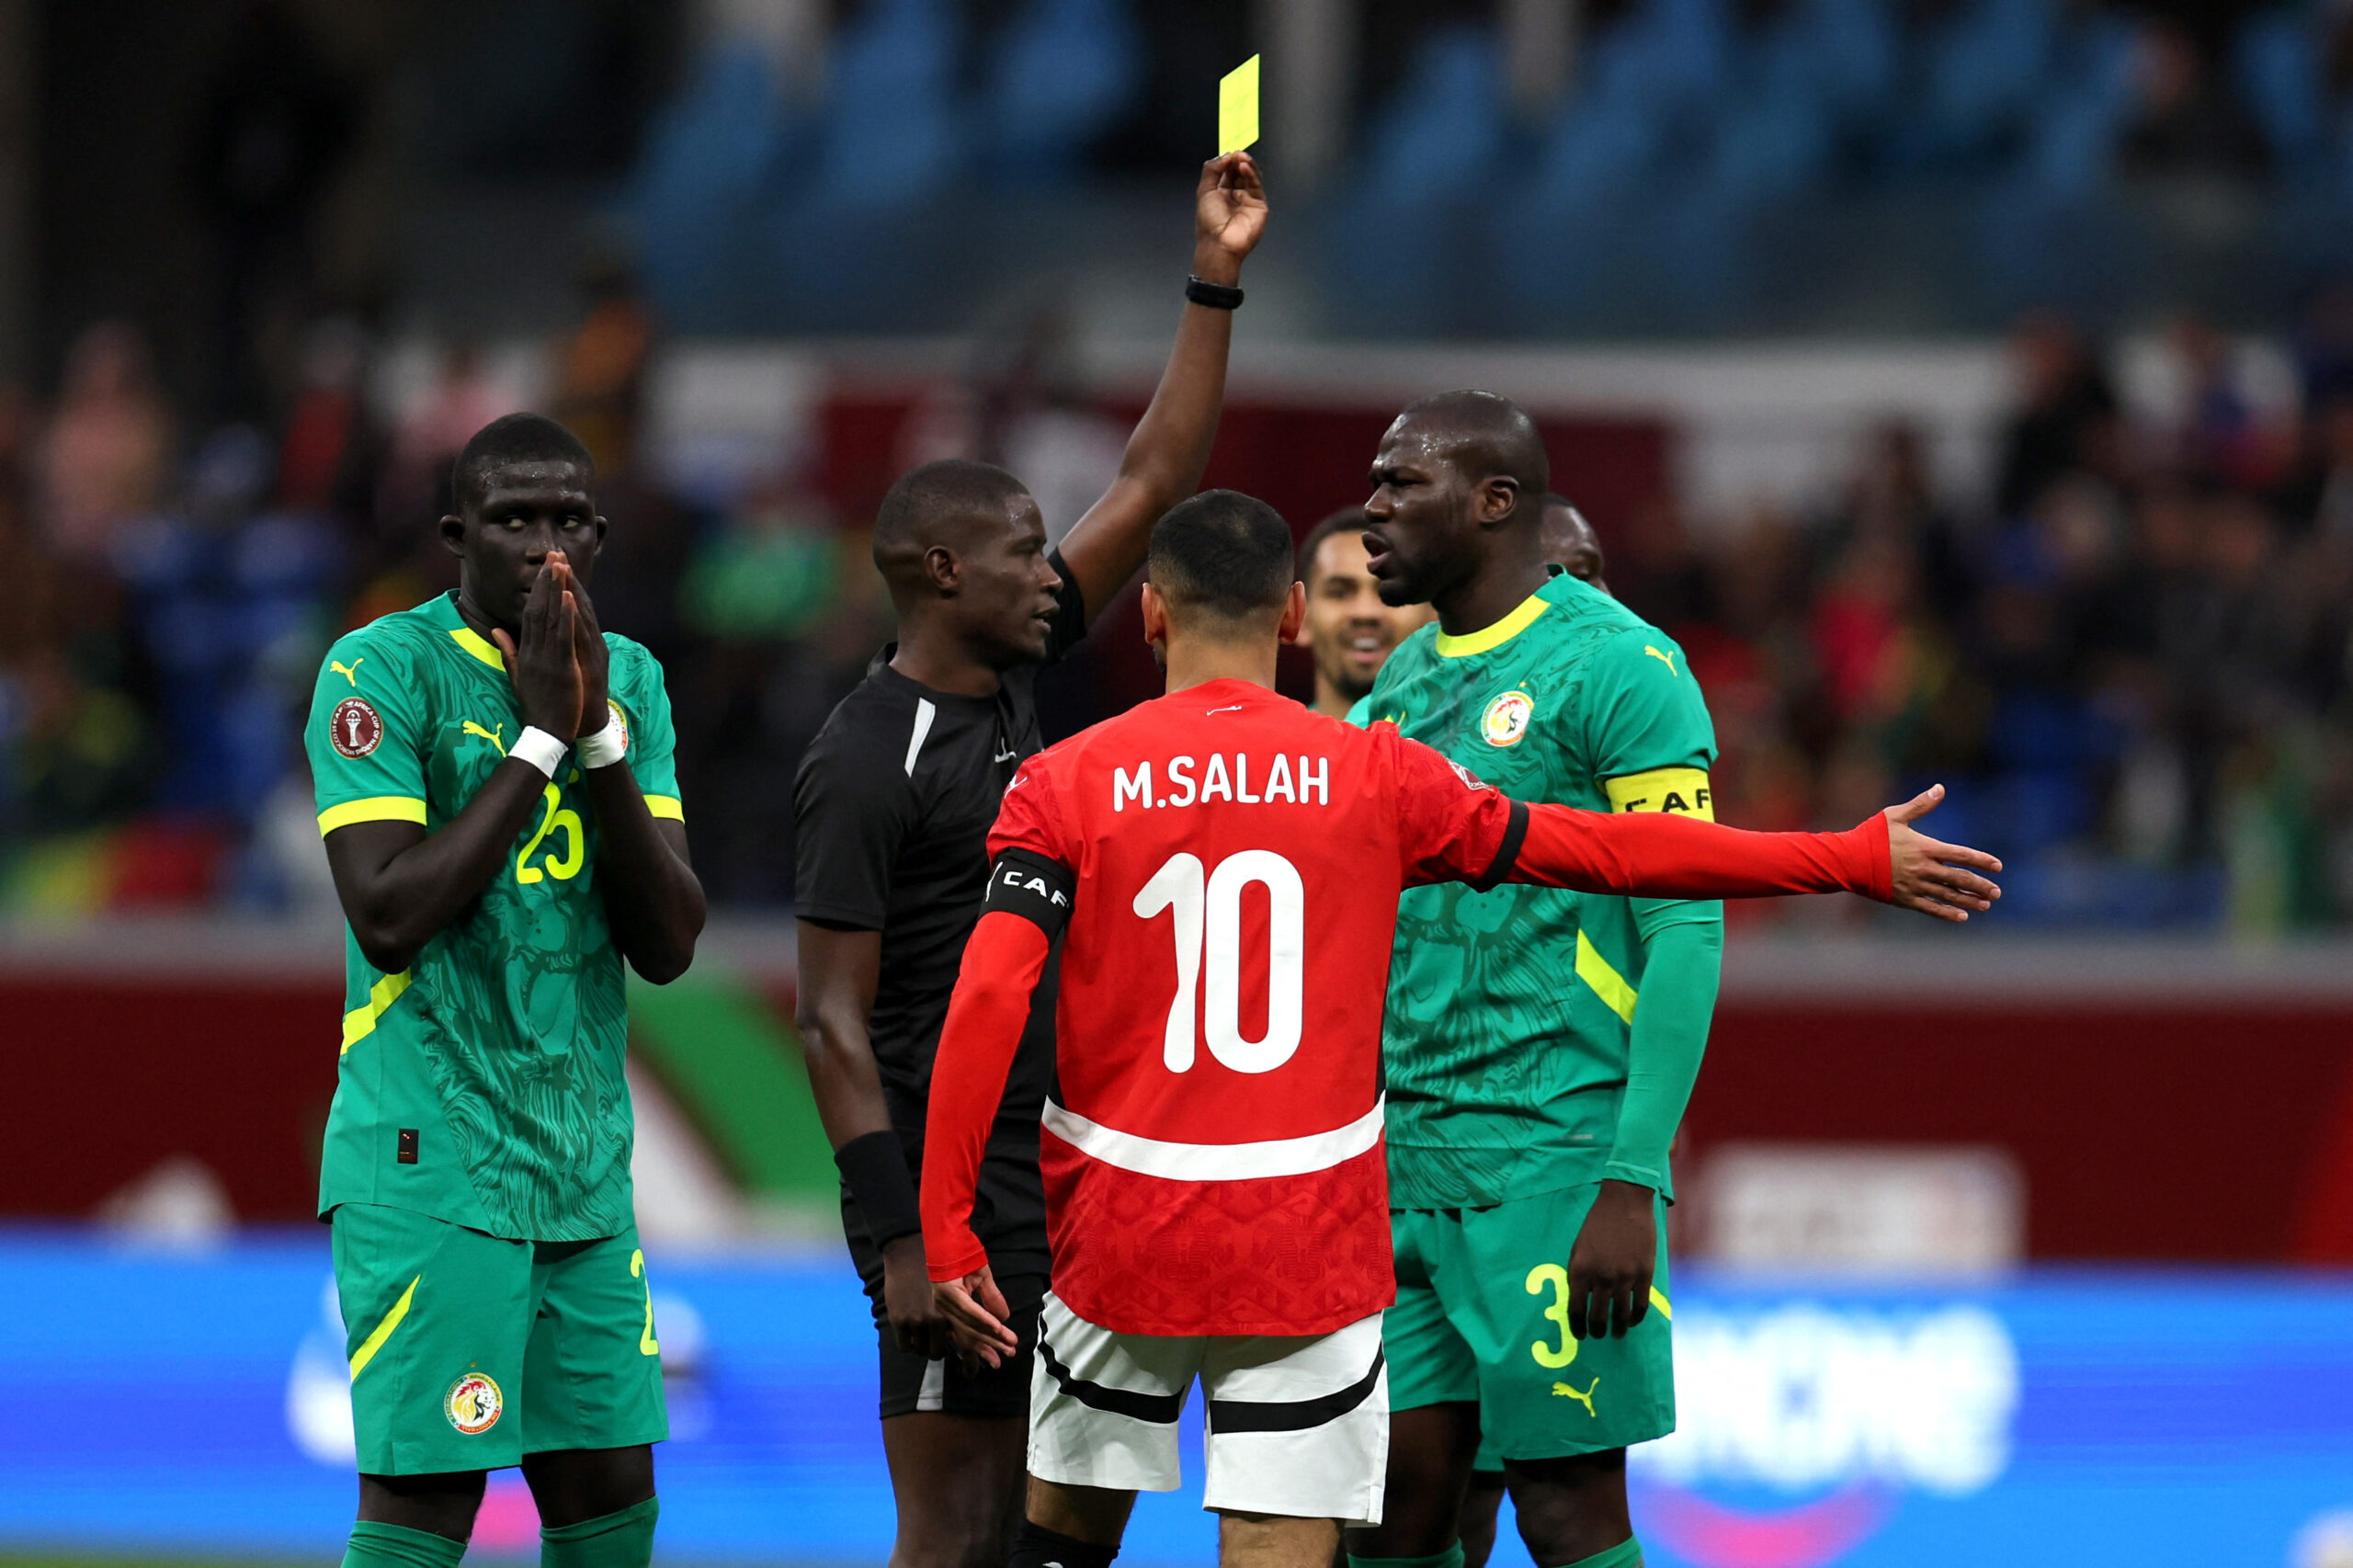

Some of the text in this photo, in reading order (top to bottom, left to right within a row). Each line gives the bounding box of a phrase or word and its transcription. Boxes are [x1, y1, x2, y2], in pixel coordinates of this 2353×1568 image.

[354, 701, 374, 717] AFRICA
[371, 716, 380, 729] CUP
[373, 730, 380, 739] OF
[1113, 753, 1329, 812] M.SALAH
[517, 767, 584, 884] 25
[1003, 870, 1067, 908] CAF
[1132, 849, 1304, 1074] 10
[1525, 1264, 1578, 1369] 3
